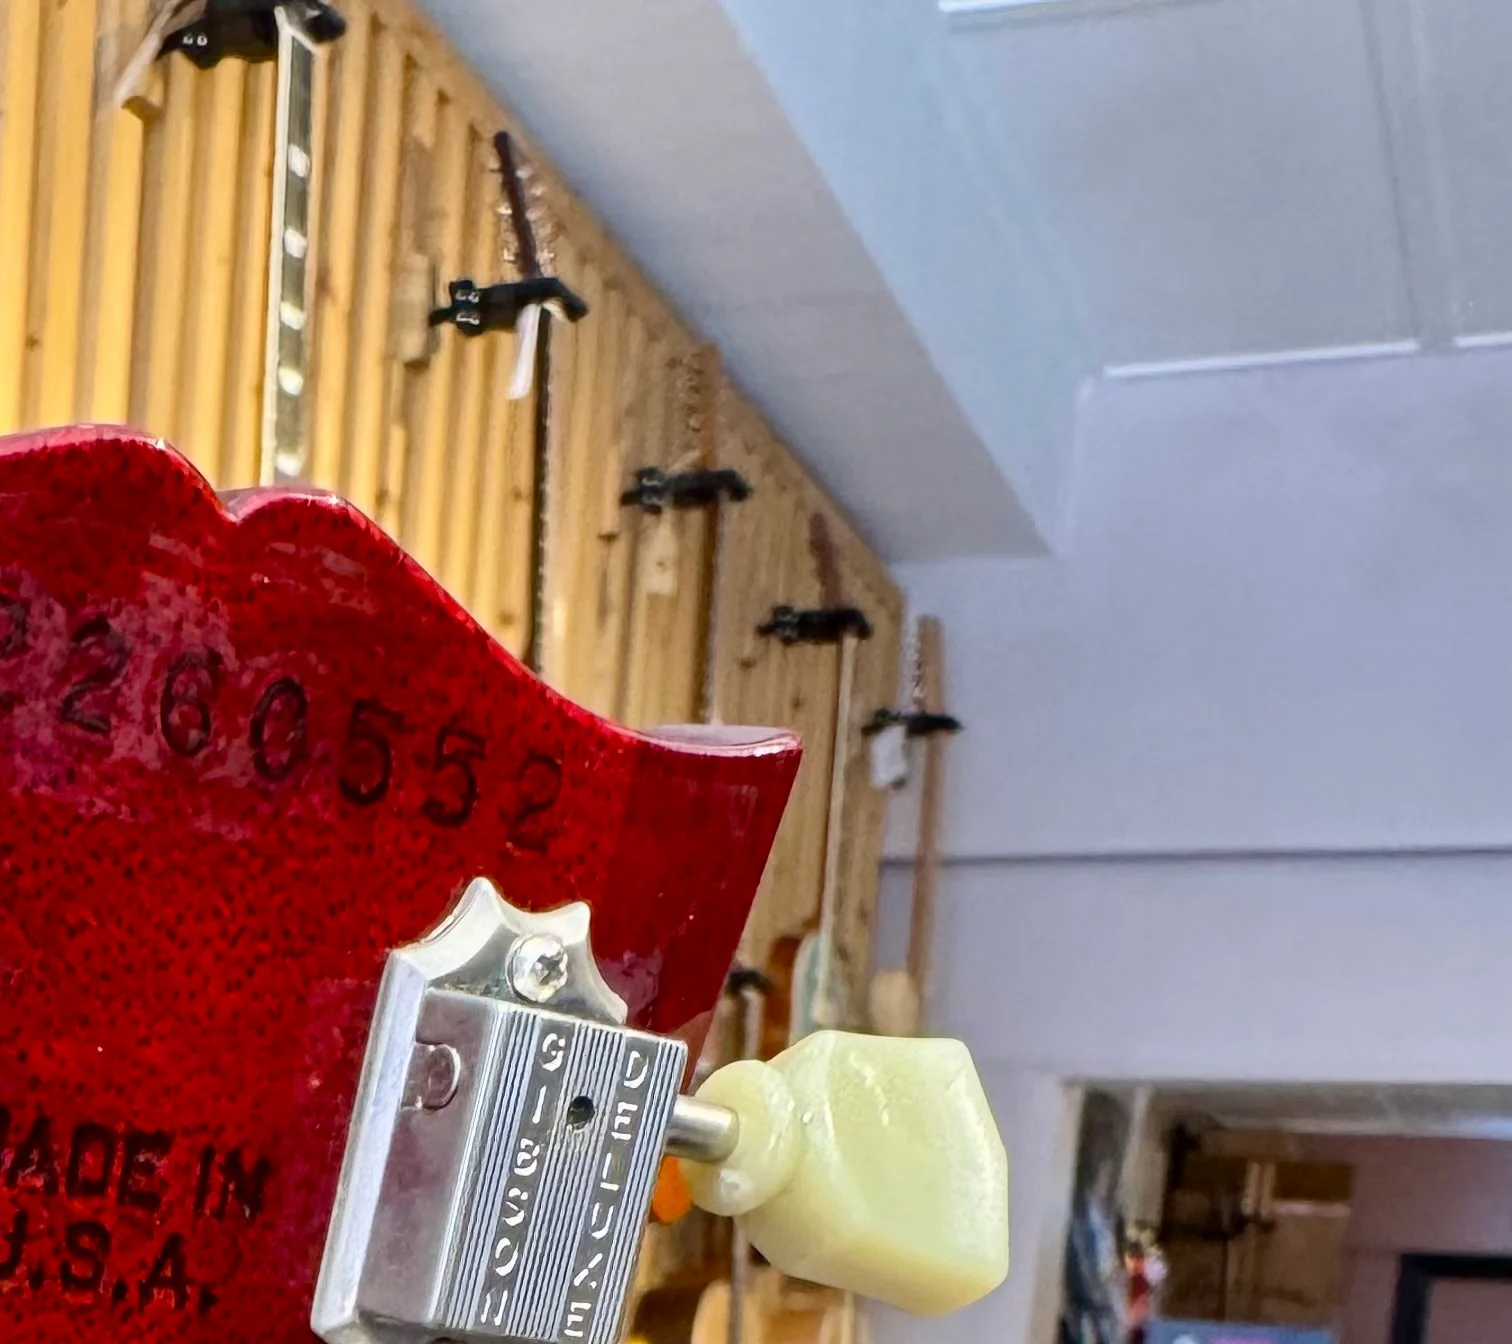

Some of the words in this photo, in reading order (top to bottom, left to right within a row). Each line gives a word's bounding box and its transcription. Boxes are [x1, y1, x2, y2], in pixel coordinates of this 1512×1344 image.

[192, 1141, 271, 1223] IN
[480, 1031, 567, 1328] GIBSON
[563, 1050, 650, 1340] DELUXE
